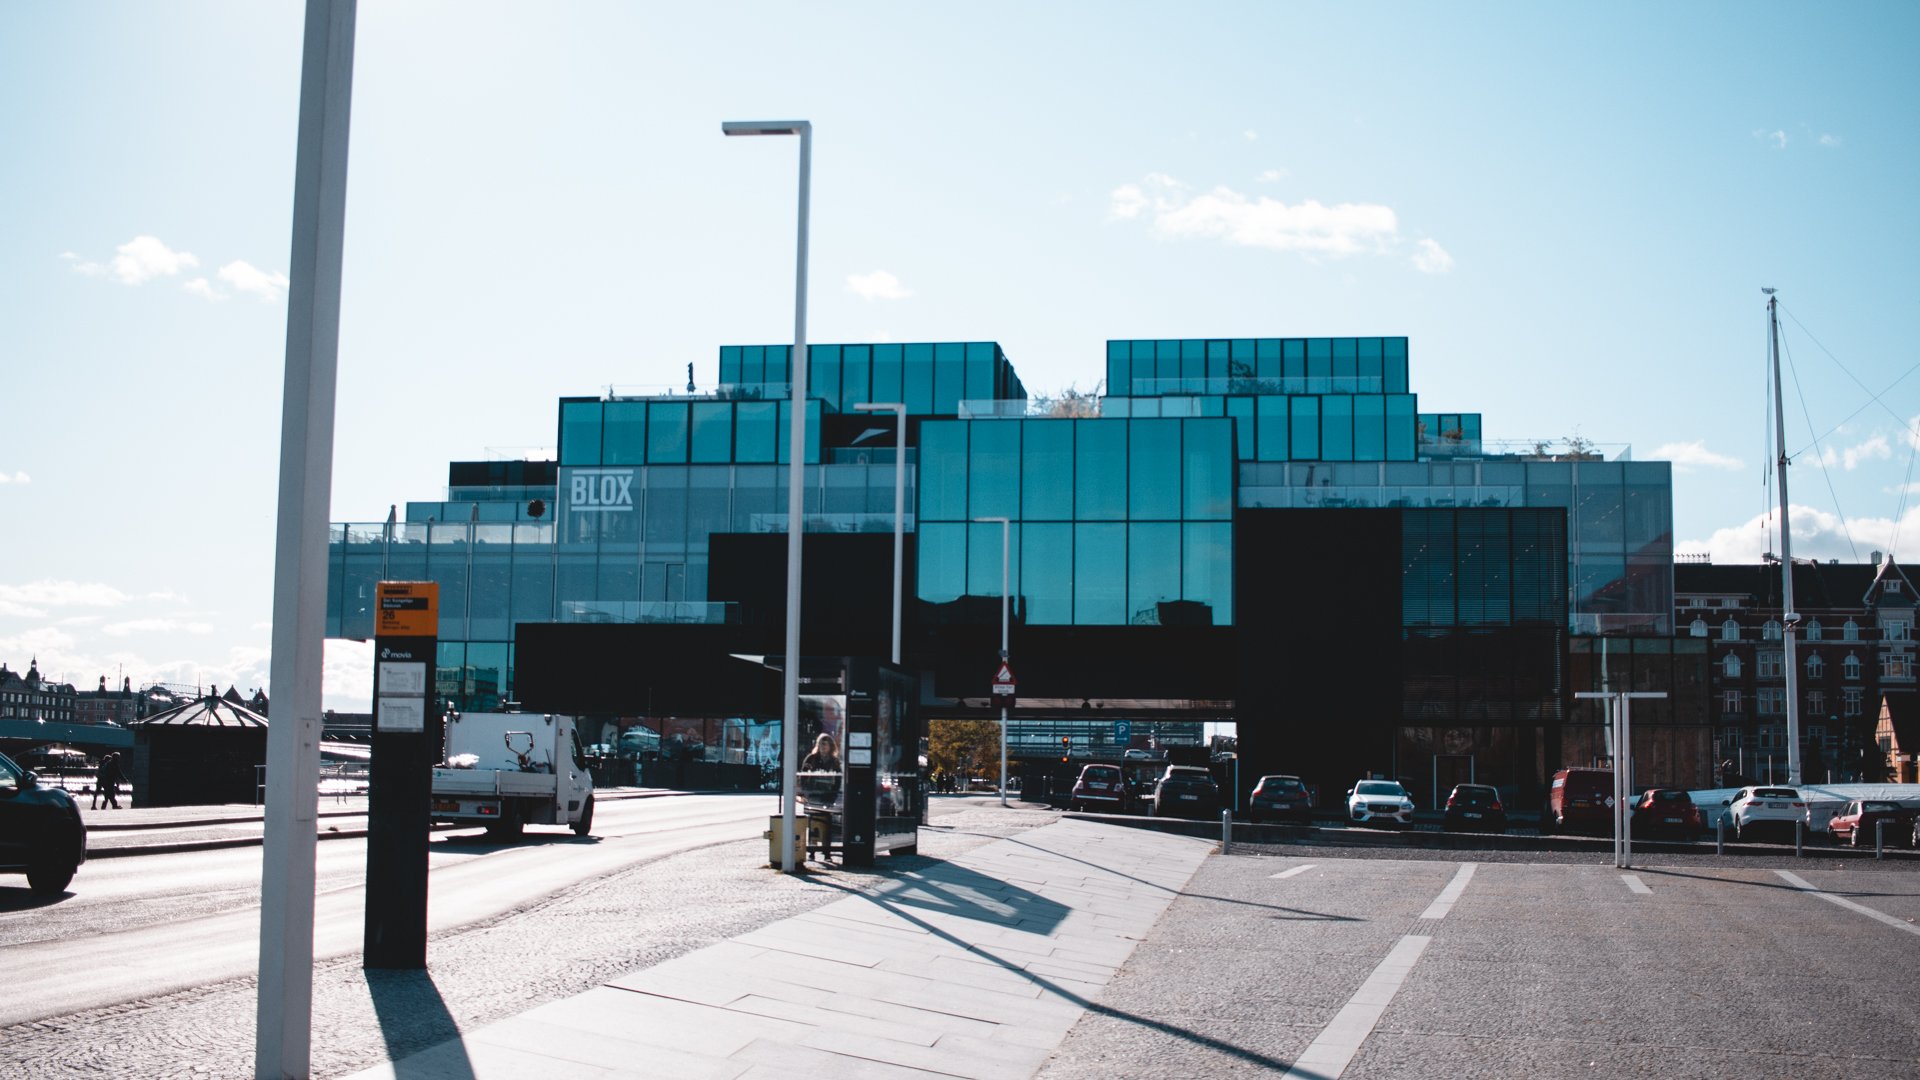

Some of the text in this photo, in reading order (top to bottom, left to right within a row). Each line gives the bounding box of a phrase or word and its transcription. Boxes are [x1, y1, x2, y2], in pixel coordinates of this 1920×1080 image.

[571, 475, 633, 505] BLOX
[382, 610, 395, 620] 26
[1119, 725, 1126, 735] P
